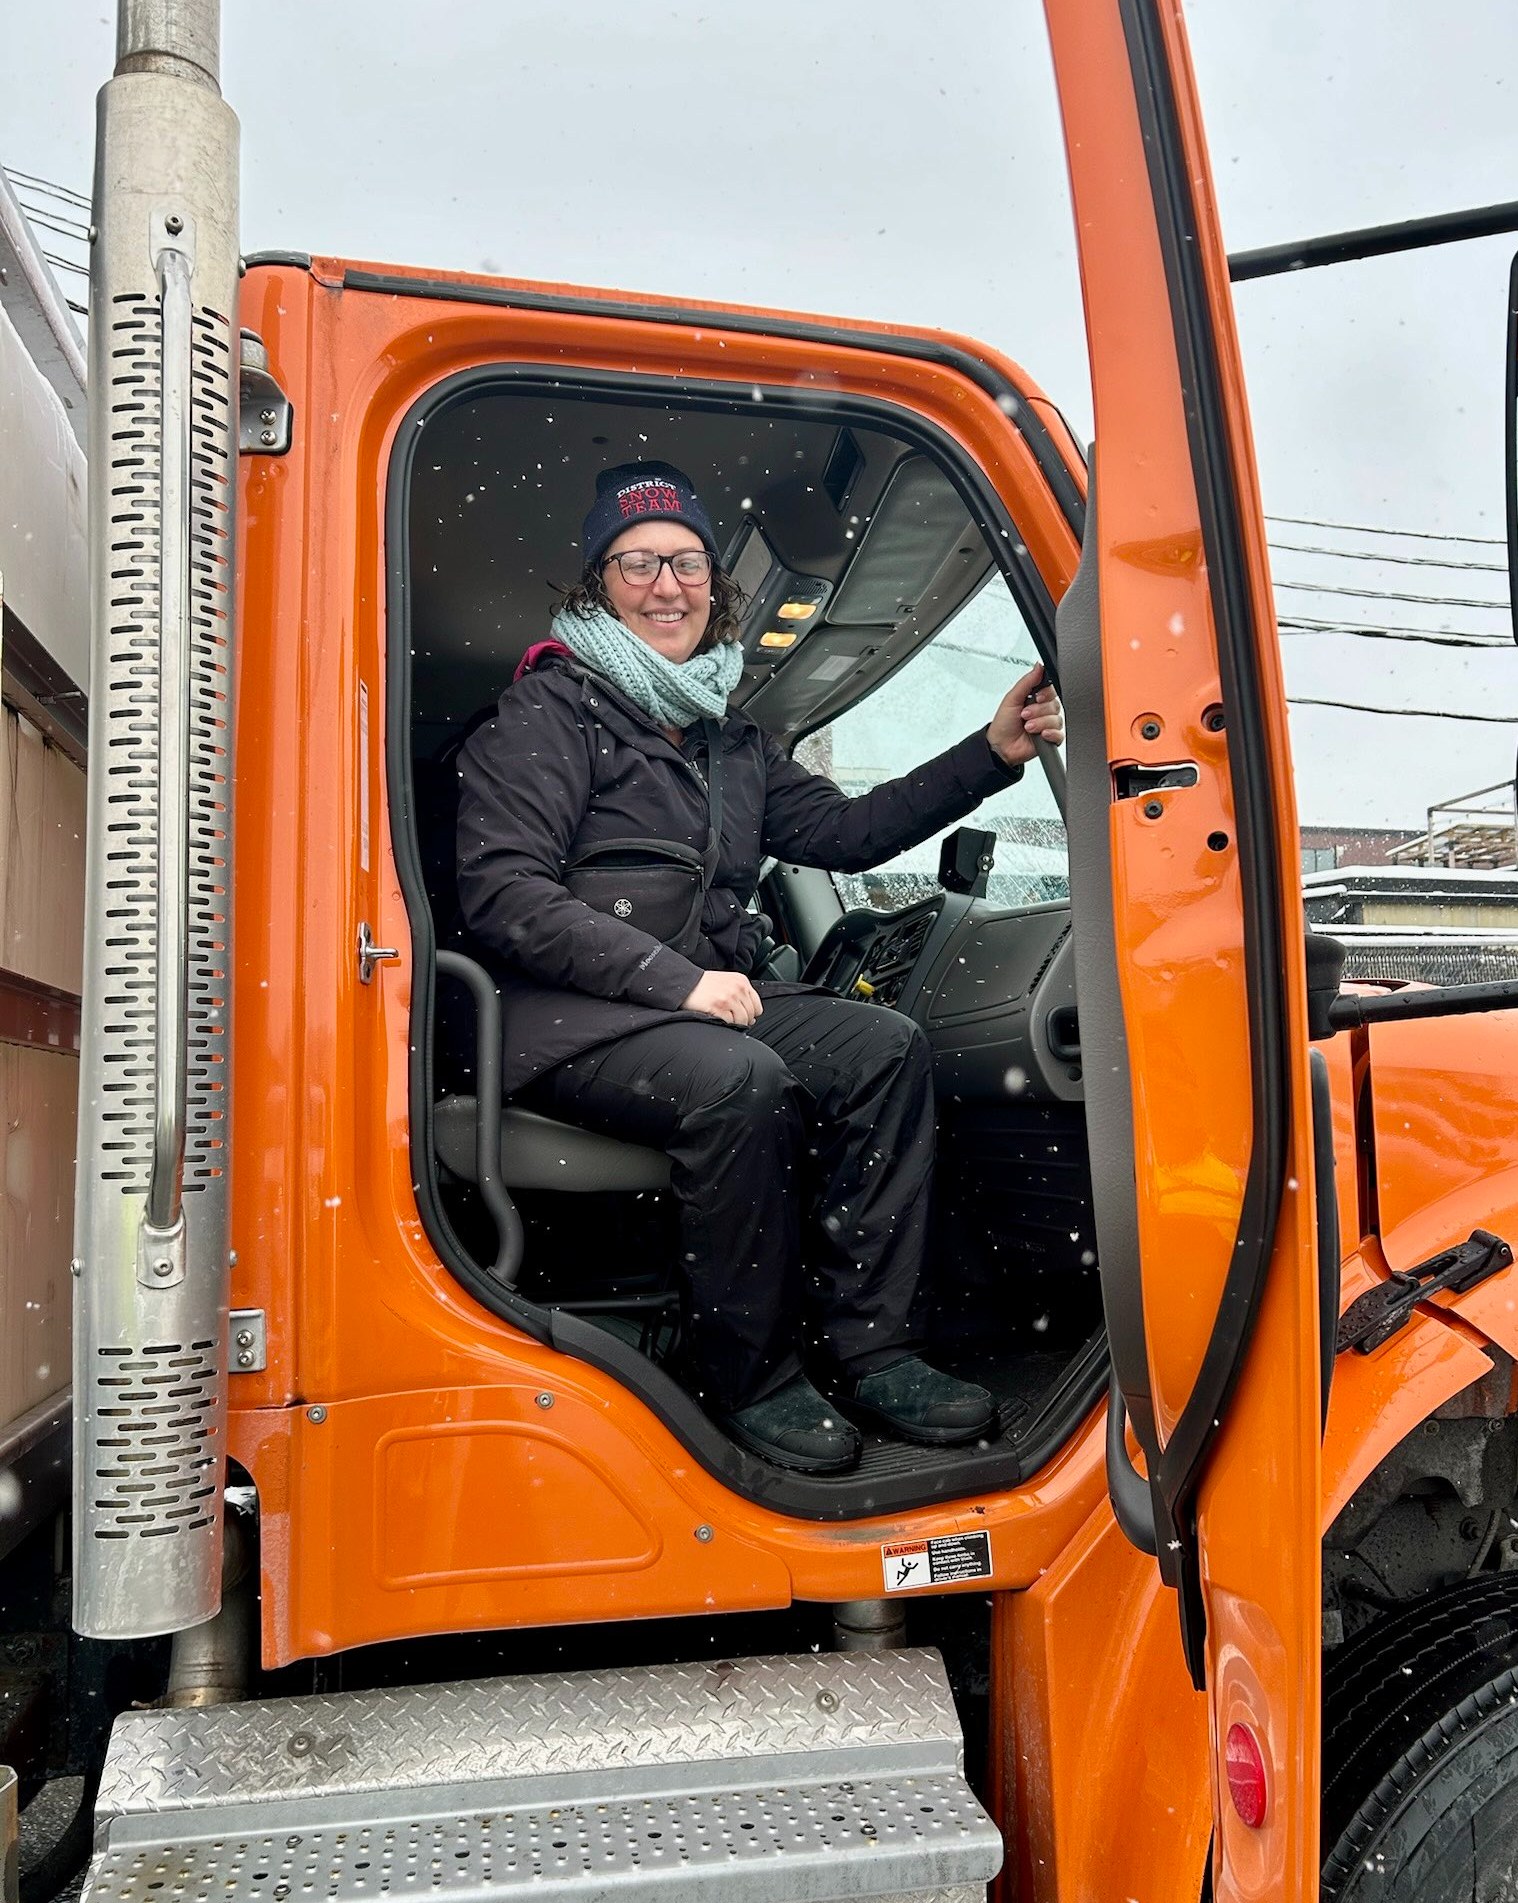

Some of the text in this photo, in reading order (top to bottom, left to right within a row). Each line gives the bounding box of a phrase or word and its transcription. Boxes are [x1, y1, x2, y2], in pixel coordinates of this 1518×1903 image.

[616, 480, 676, 499] DISTRICT
[619, 487, 677, 508] SNOW
[621, 498, 684, 520] TEAM
[892, 1544, 926, 1554] WARNING
